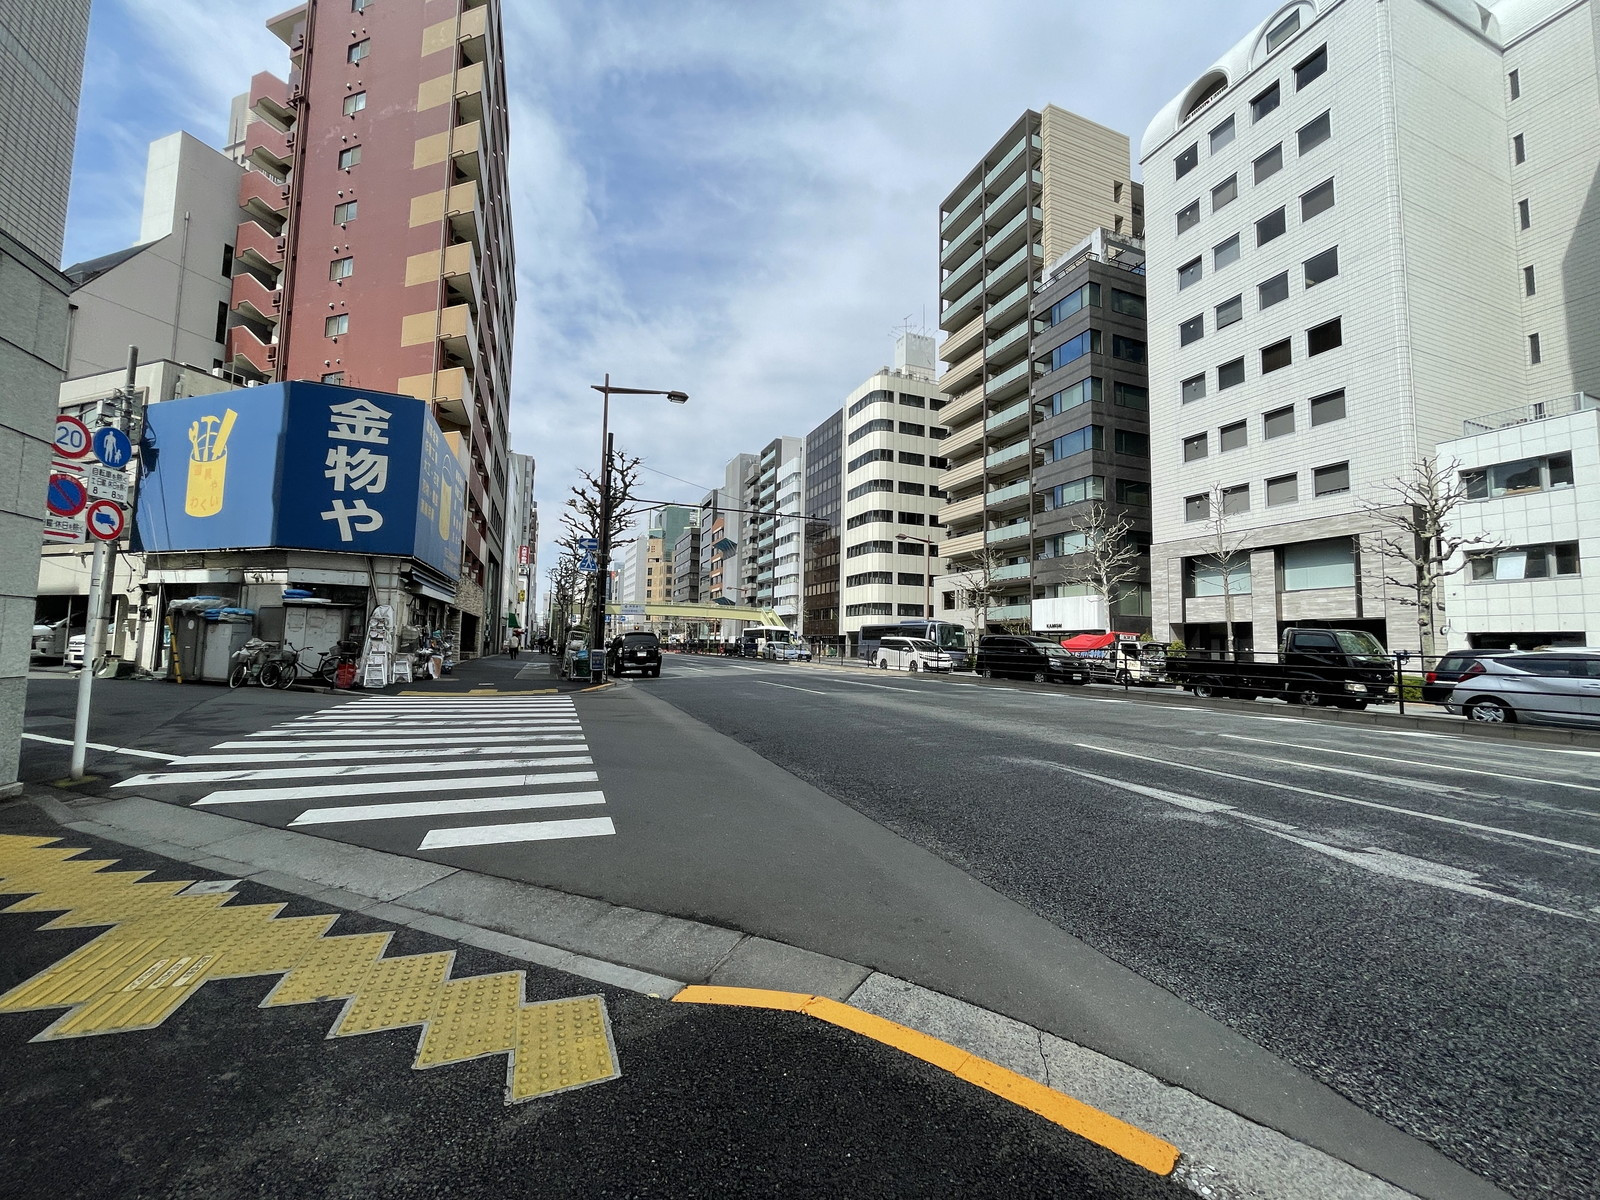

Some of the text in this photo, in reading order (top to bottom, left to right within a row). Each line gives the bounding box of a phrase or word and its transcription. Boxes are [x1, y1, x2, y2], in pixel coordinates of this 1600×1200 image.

[56, 425, 83, 448] 20
[320, 398, 393, 542] 金物や
